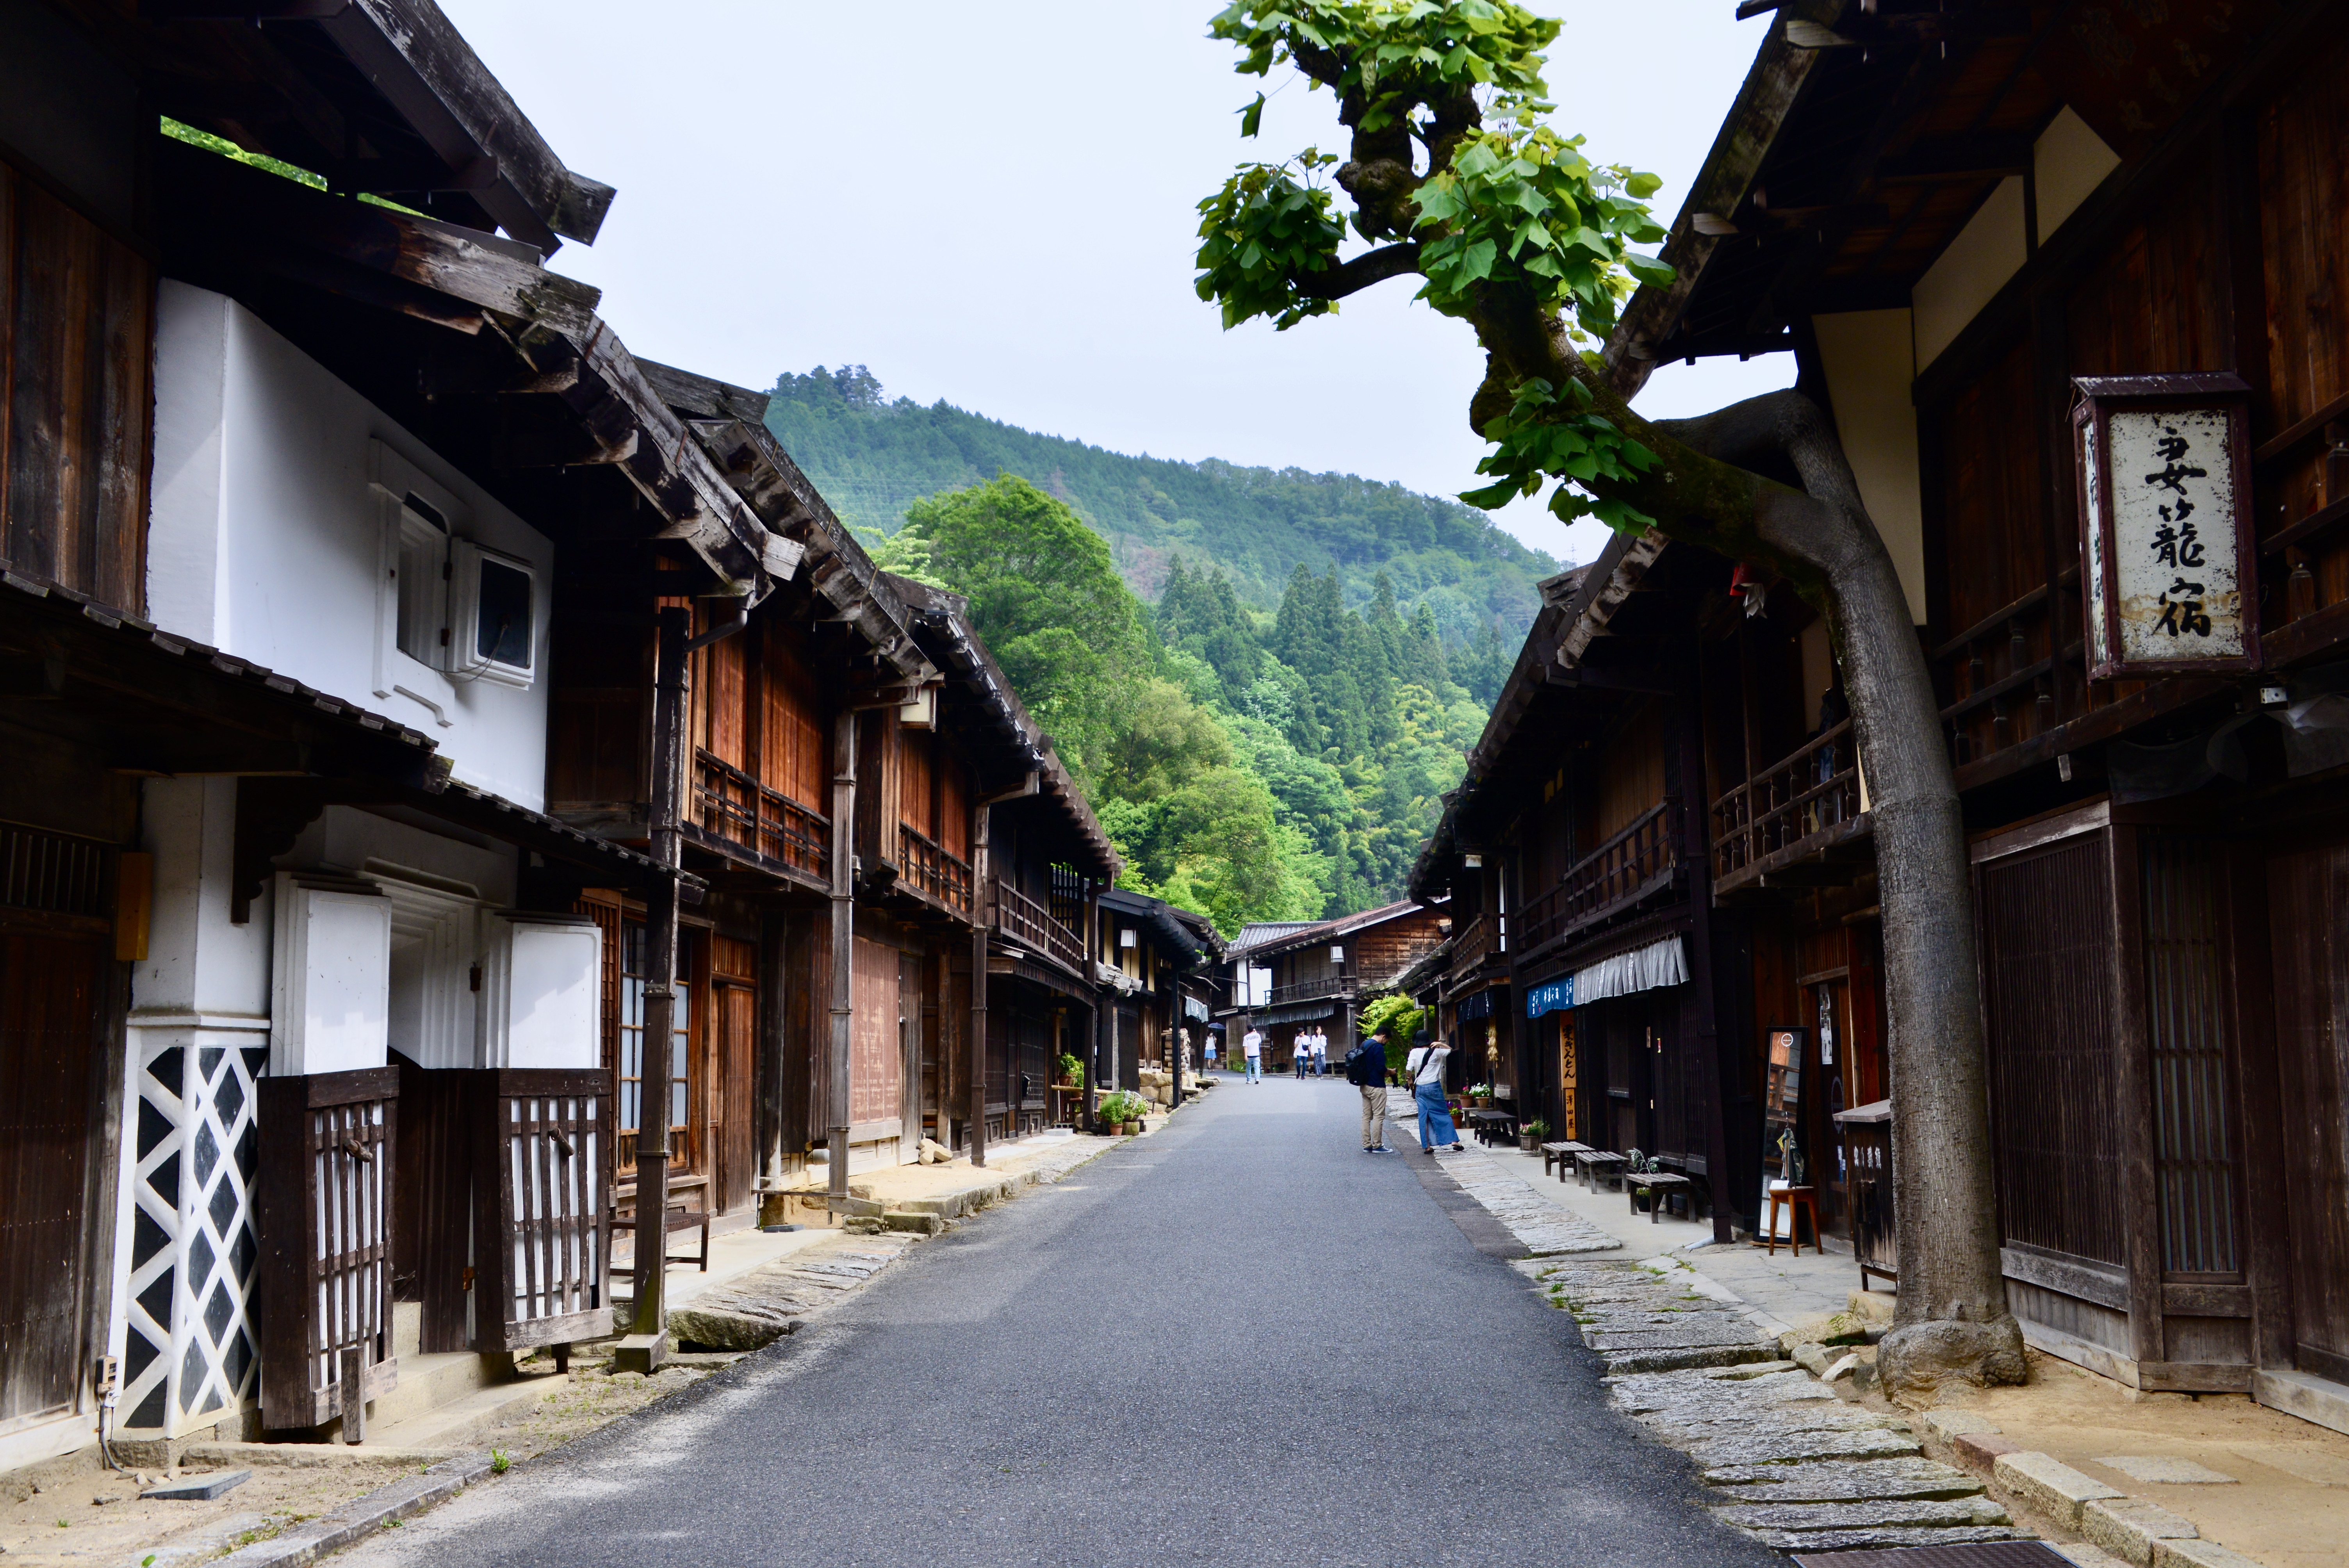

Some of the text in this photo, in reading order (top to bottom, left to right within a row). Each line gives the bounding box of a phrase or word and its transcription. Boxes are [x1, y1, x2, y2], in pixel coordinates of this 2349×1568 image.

[2145, 427, 2211, 638] 妻籠宿
[1562, 1024, 1576, 1079] 栗きんとん
[1566, 1095, 1574, 1130] 澤田屋
